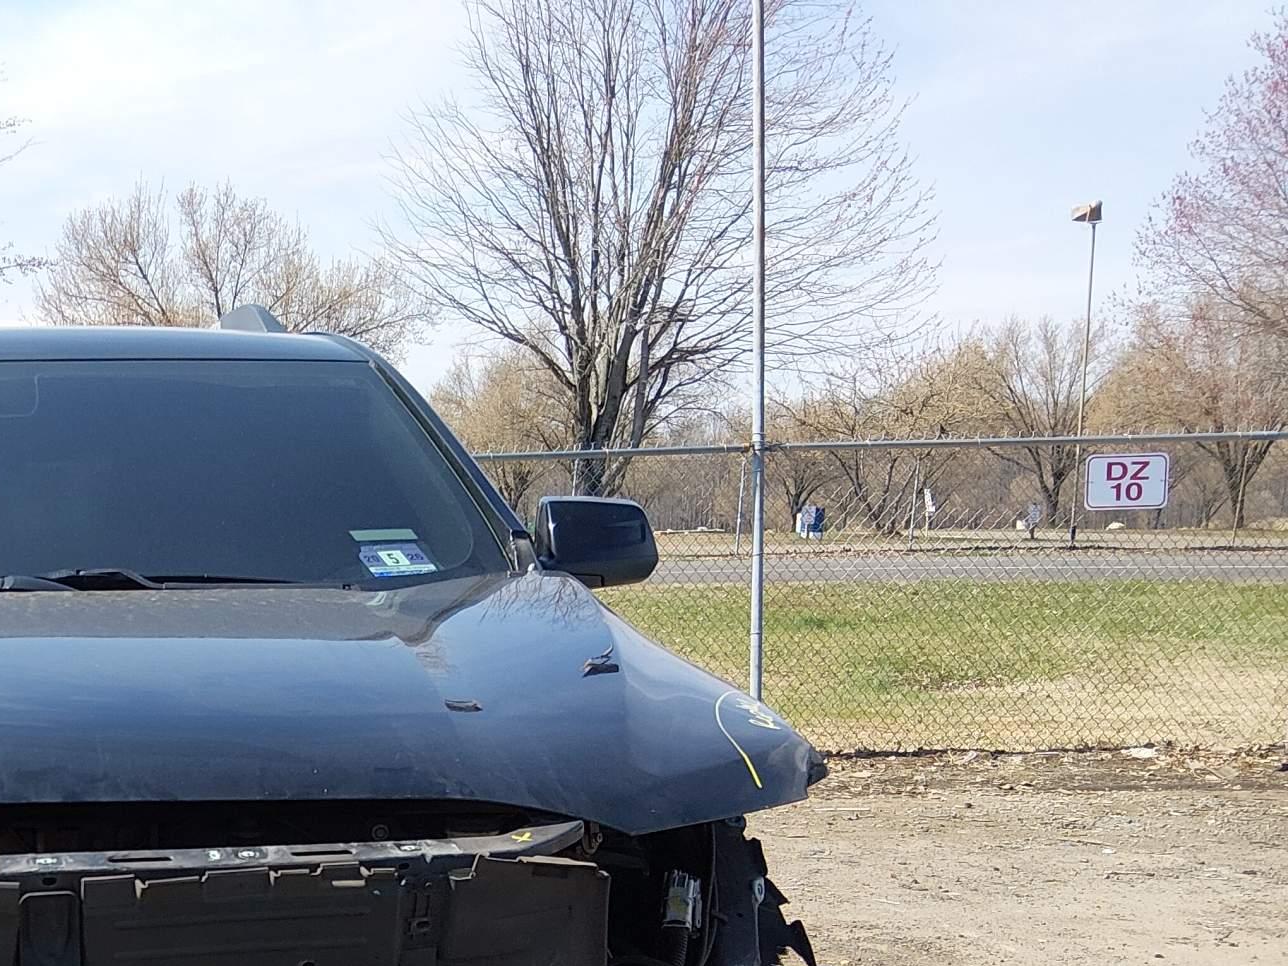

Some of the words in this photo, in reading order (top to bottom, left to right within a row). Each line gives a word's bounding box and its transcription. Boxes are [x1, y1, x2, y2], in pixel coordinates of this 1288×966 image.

[1106, 460, 1150, 481] DZ
[1110, 482, 1143, 501] 10
[386, 553, 400, 565] 5
